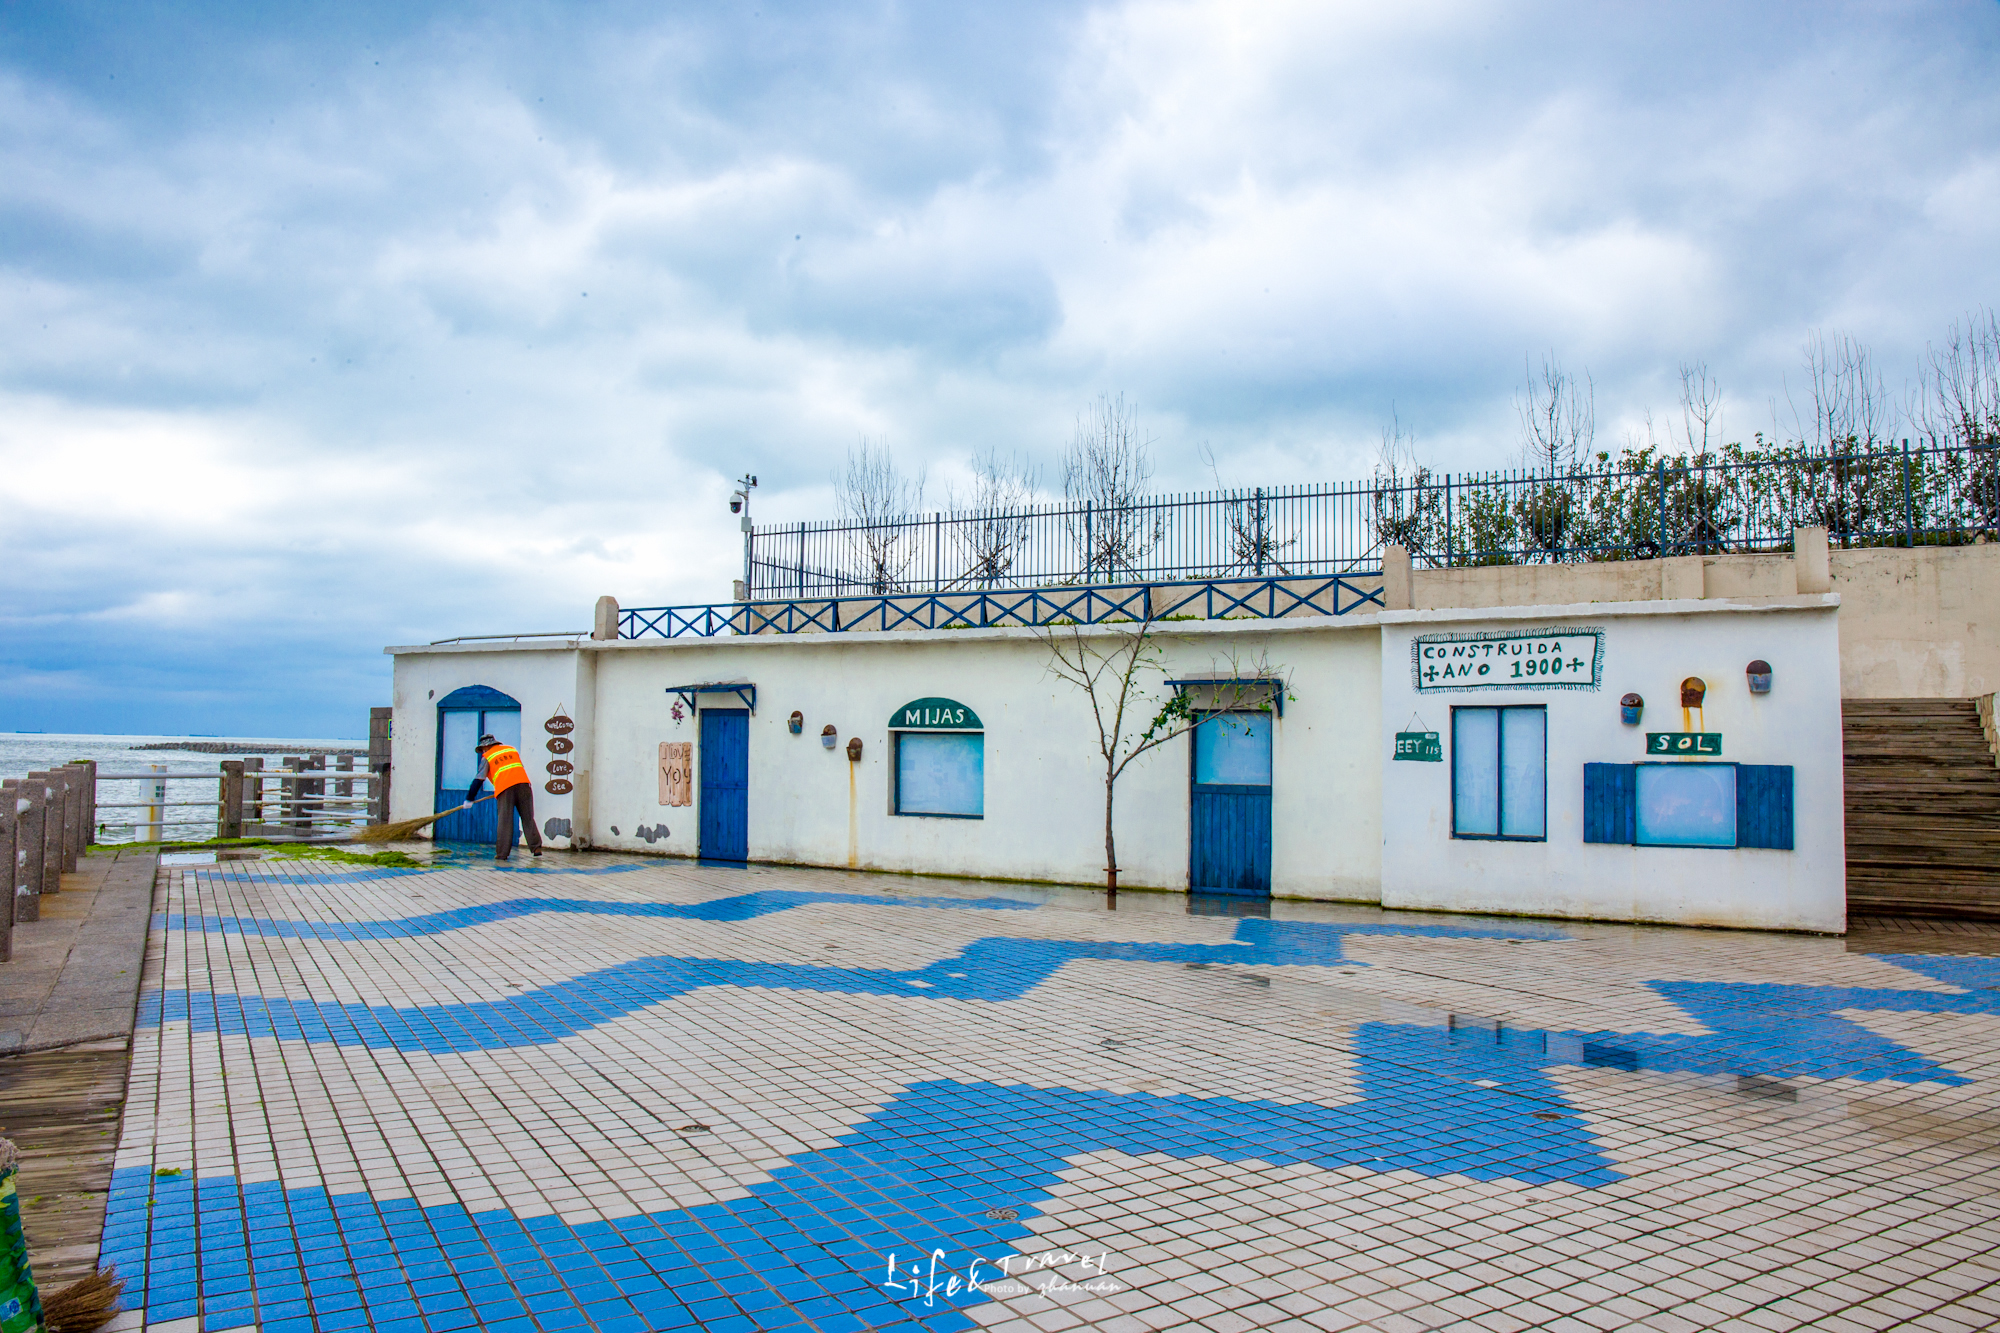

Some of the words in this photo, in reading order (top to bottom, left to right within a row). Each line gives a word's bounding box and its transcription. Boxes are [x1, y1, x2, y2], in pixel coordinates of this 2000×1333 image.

[1423, 642, 1562, 659] CONSTRUIDA
[1510, 657, 1563, 678] 1900
[905, 708, 964, 725] MIJAS
[554, 740, 565, 751] to
[1397, 739, 1422, 753] EEY
[1656, 735, 1713, 751] SOL
